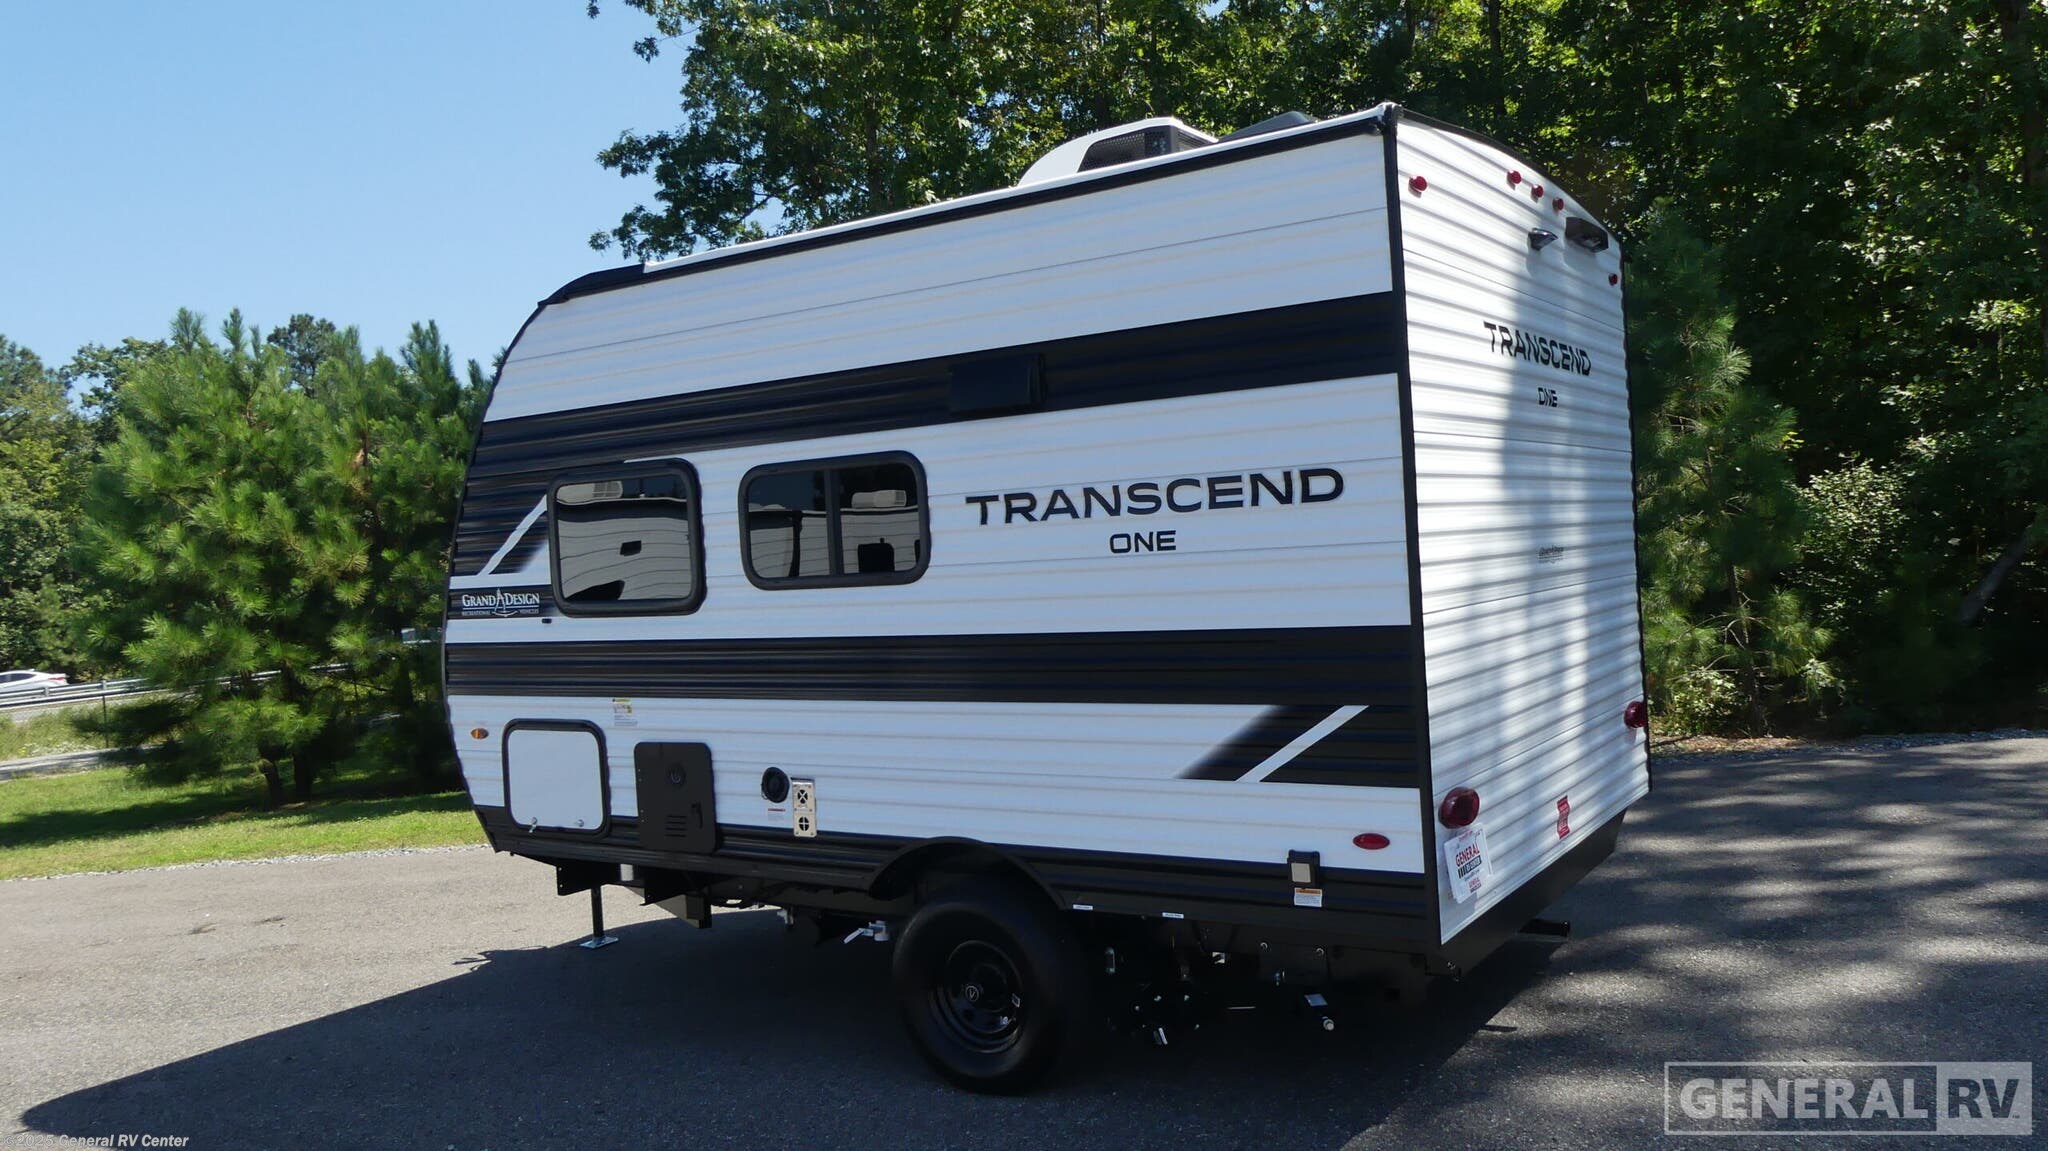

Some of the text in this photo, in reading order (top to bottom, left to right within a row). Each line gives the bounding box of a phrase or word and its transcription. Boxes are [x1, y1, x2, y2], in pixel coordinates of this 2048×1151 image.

[1483, 321, 1592, 376] TRANSCEND
[1537, 387, 1558, 408] ONE
[965, 467, 1344, 526] TRANSCEND
[1109, 529, 1177, 554] ONE
[462, 592, 540, 607] GRAND DESIGN
[1455, 843, 1480, 867] GENERAL
